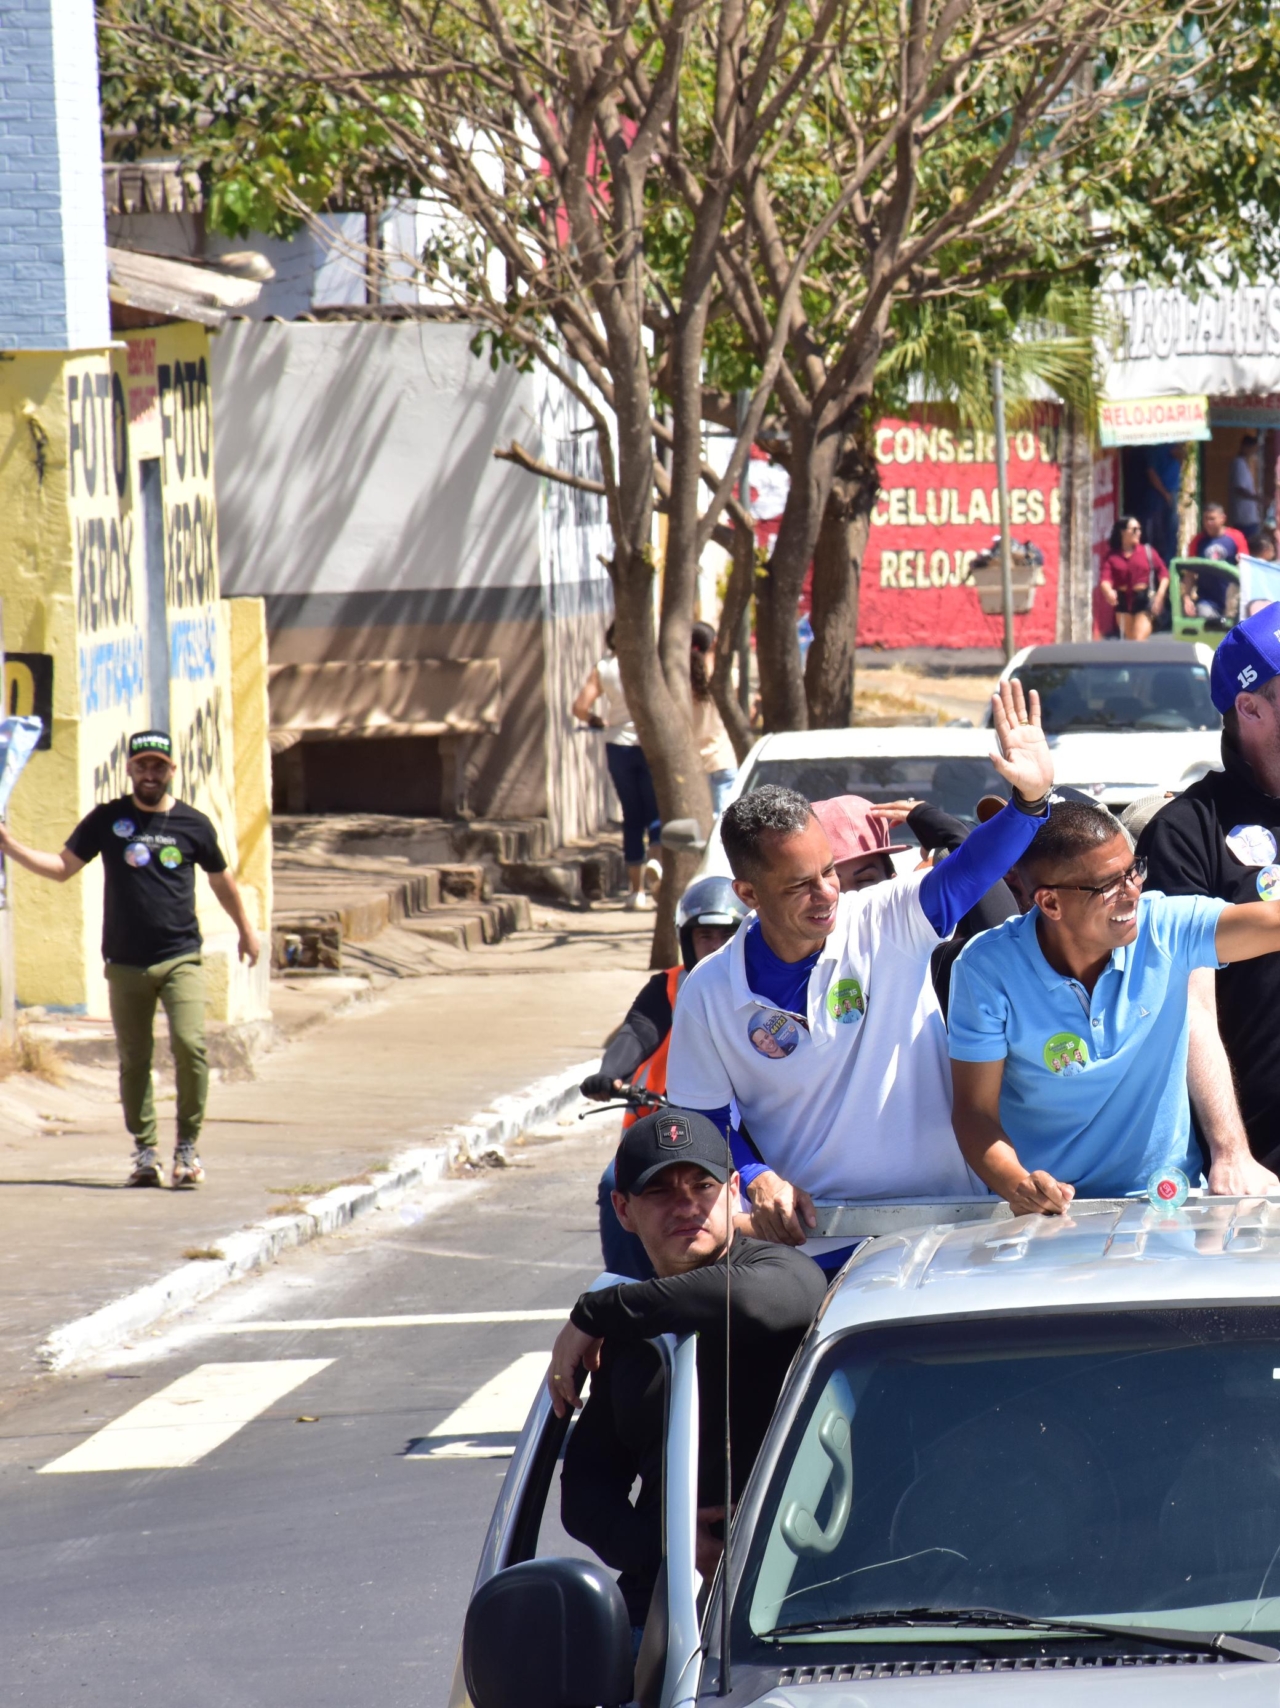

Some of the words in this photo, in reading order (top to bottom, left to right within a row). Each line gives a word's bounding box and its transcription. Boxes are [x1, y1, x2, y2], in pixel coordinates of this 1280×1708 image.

[68, 371, 129, 499] FOTO
[158, 356, 210, 484] FOTO
[1102, 402, 1205, 427] RELOJOARIA
[76, 511, 134, 633] XEROX
[165, 493, 216, 608] XEROX
[1236, 664, 1258, 689] 15
